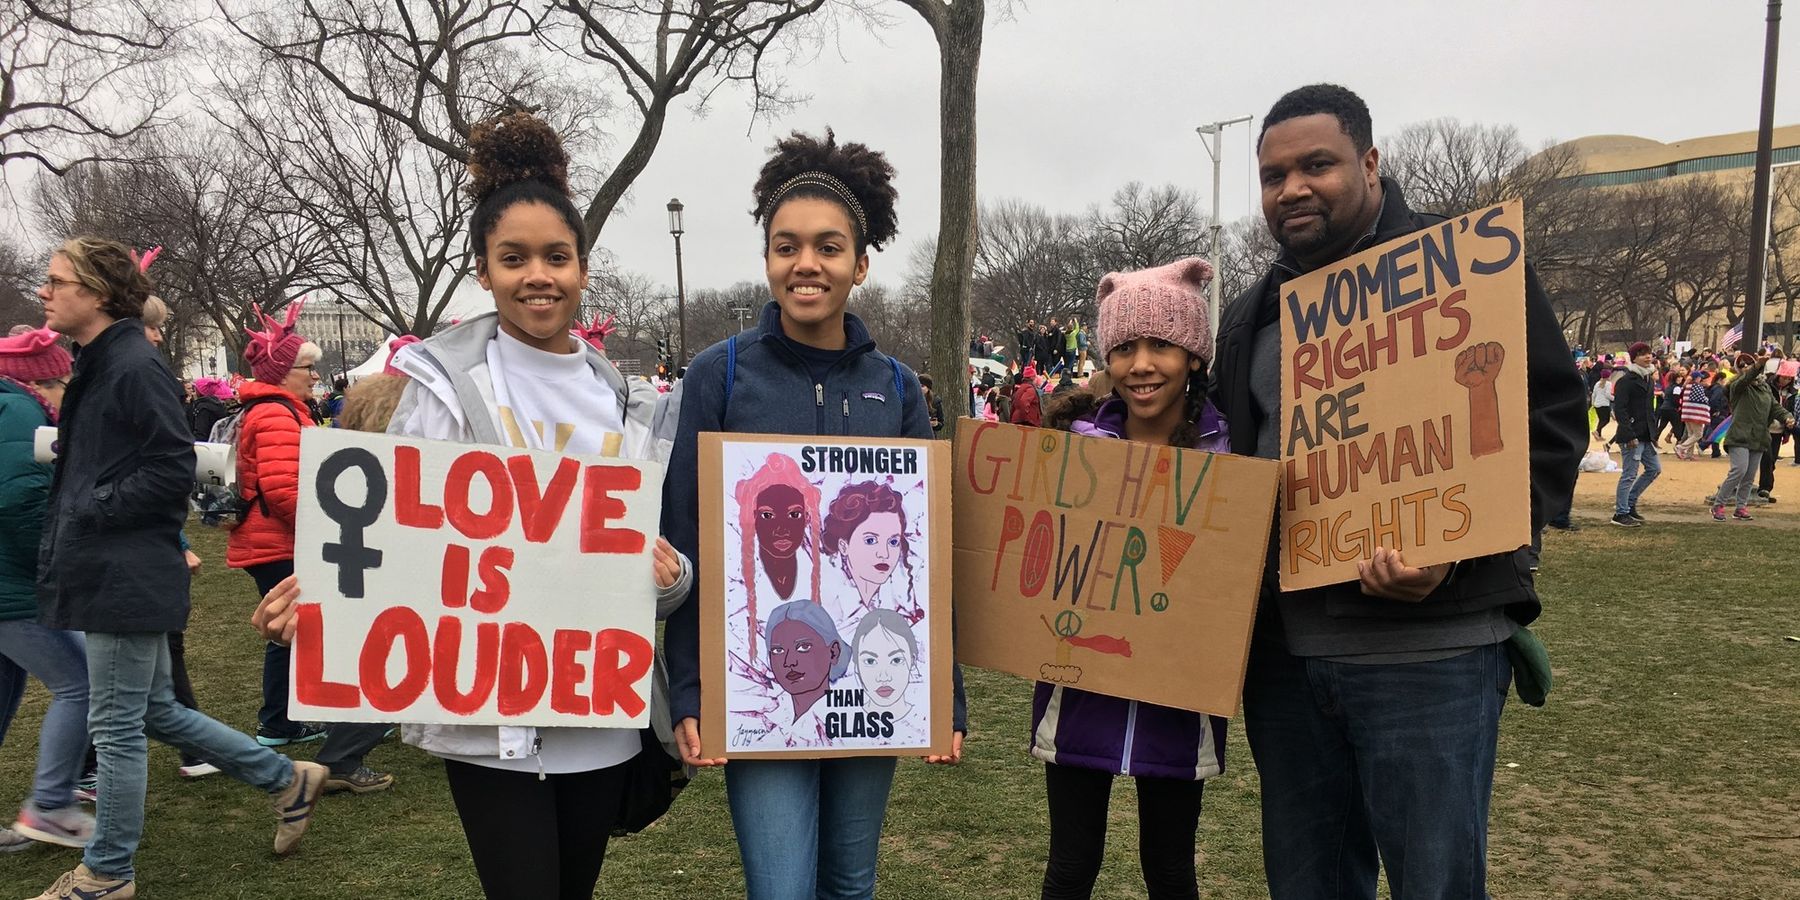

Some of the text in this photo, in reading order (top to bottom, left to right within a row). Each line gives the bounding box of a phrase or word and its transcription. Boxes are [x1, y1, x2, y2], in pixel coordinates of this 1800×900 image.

[1286, 206, 1521, 343] WOMEN'S
[1293, 289, 1471, 399] RIGHTS
[801, 446, 917, 474] STRONGER
[1286, 382, 1369, 456] ARE
[1286, 415, 1453, 511] HUMAN
[394, 445, 646, 553] LOVE
[968, 422, 1237, 532] GIRLS HAVE
[1289, 484, 1471, 574] RIGHTS
[441, 543, 515, 613] IS
[296, 603, 654, 719] LOUDER
[825, 689, 864, 707] THAN
[825, 711, 894, 739] GLASS
